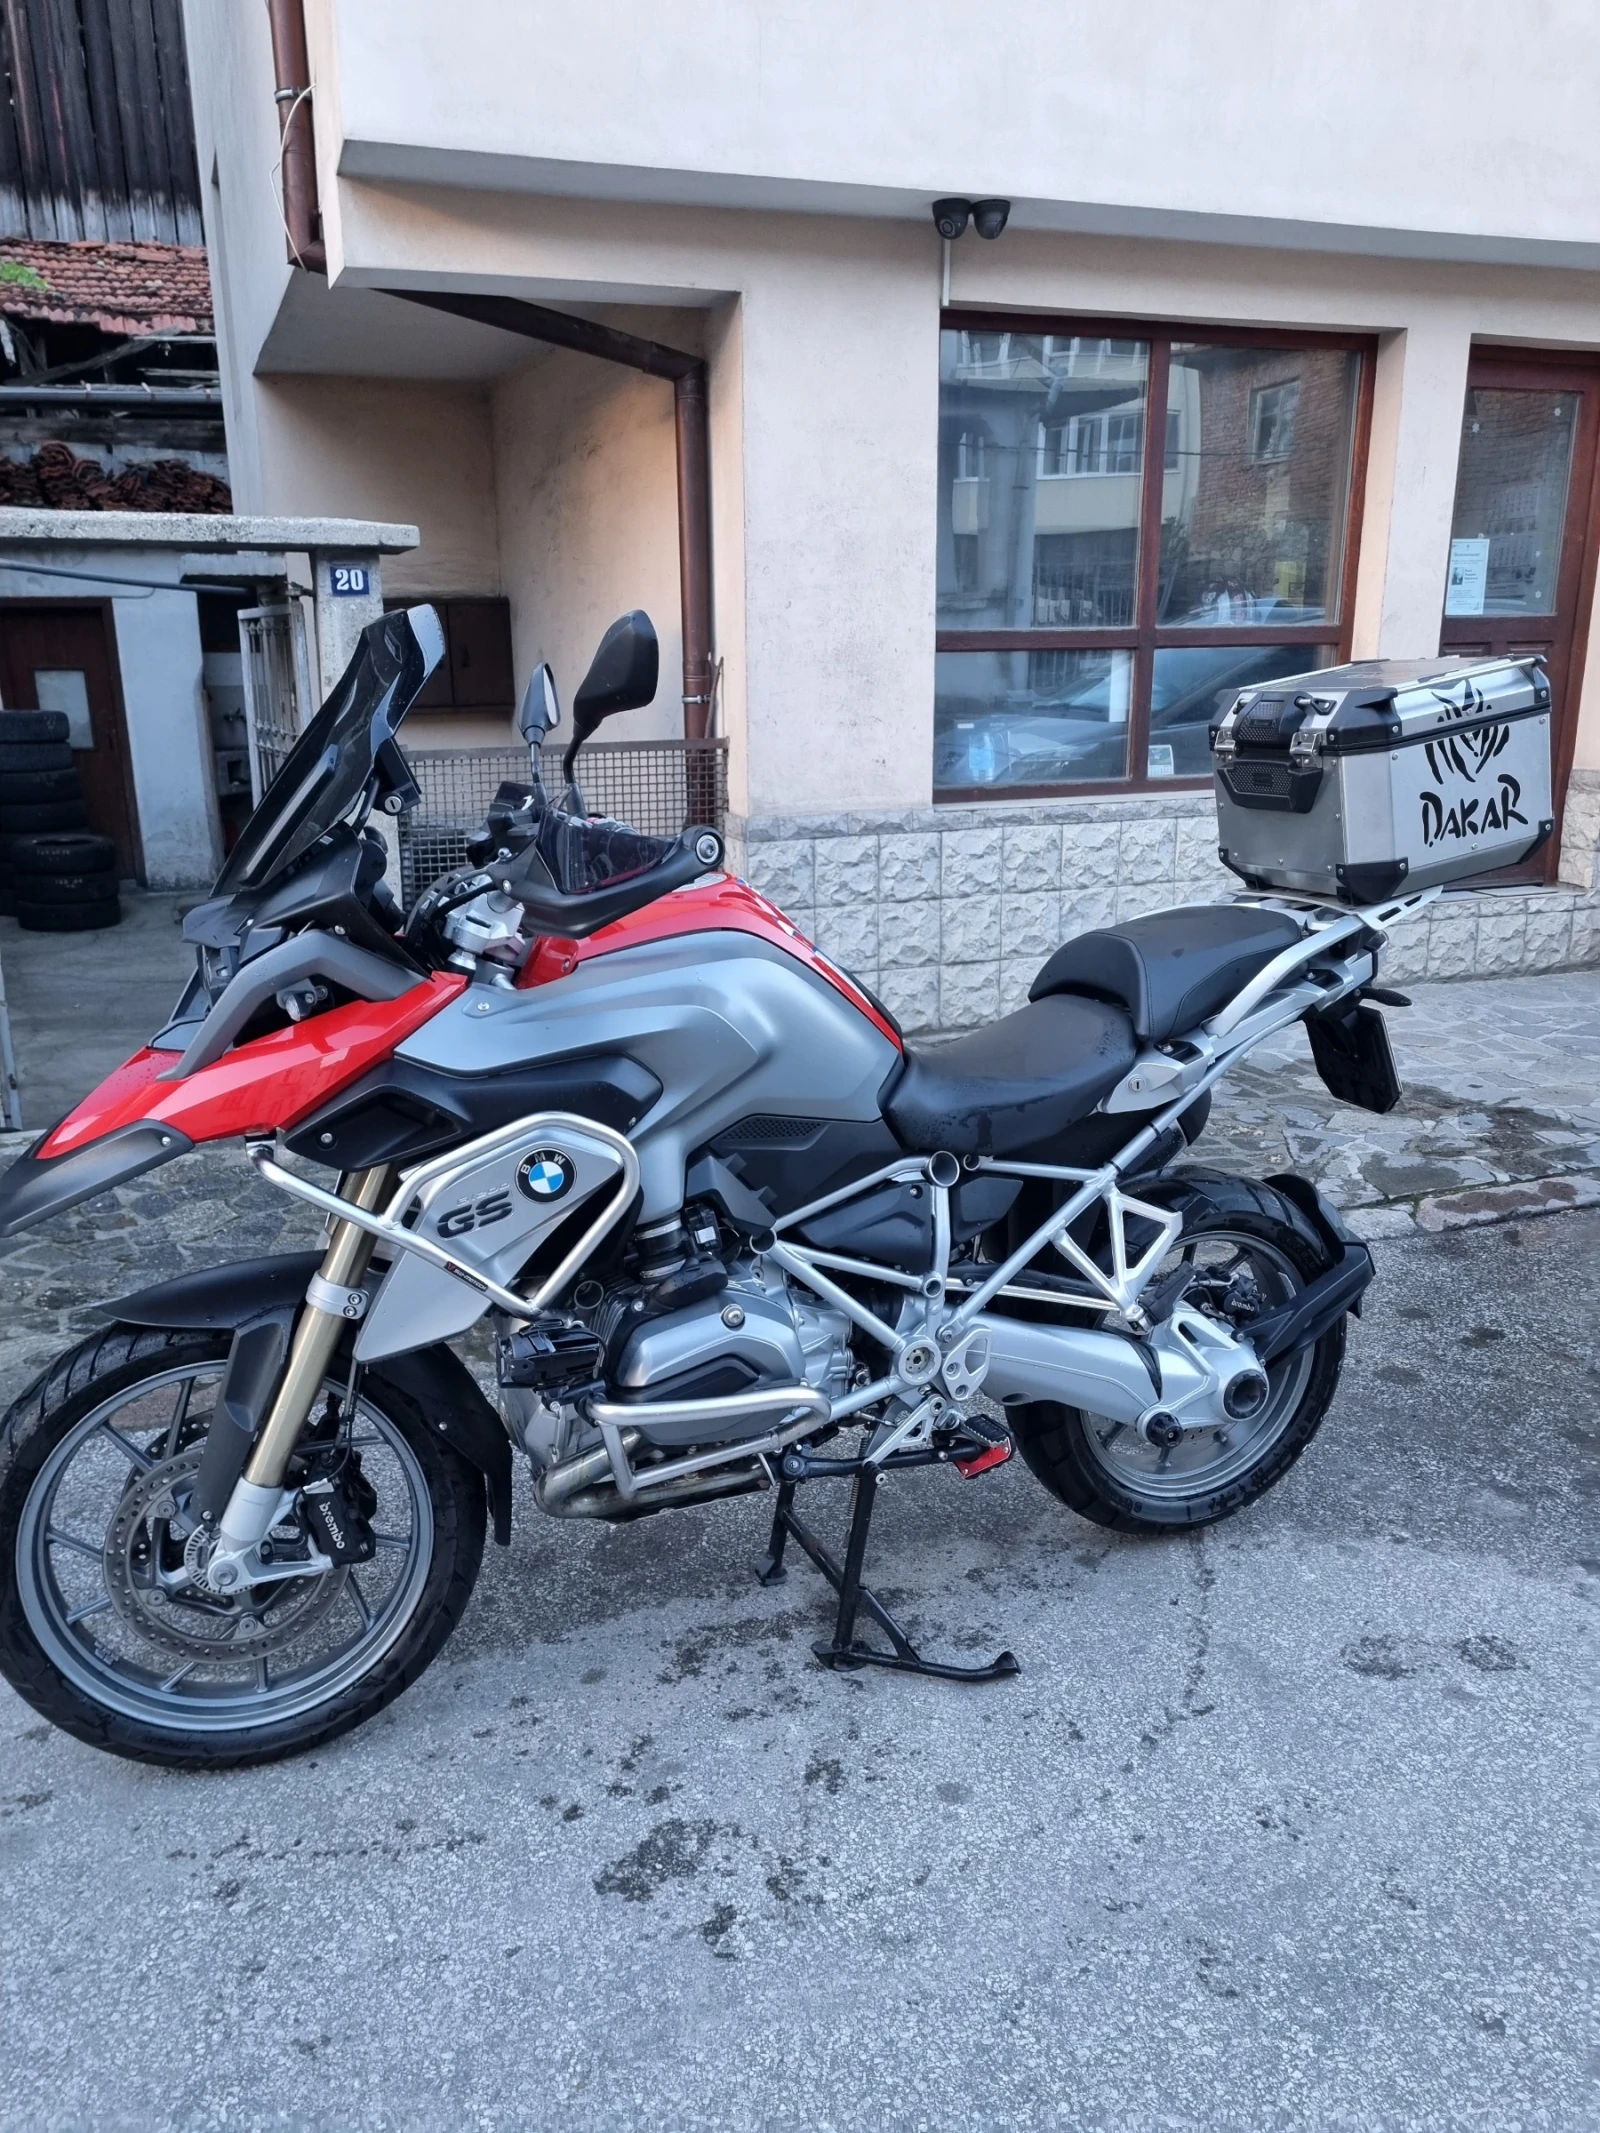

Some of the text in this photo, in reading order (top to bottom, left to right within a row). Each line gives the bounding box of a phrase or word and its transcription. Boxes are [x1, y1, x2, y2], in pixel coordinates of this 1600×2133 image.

[335, 568, 364, 591] 20
[1420, 773, 1529, 848] DAKAR
[520, 1152, 566, 1175] BMW
[437, 1190, 513, 1239] GS
[1231, 1298, 1255, 1312] brembo
[319, 1501, 345, 1549] brembo
